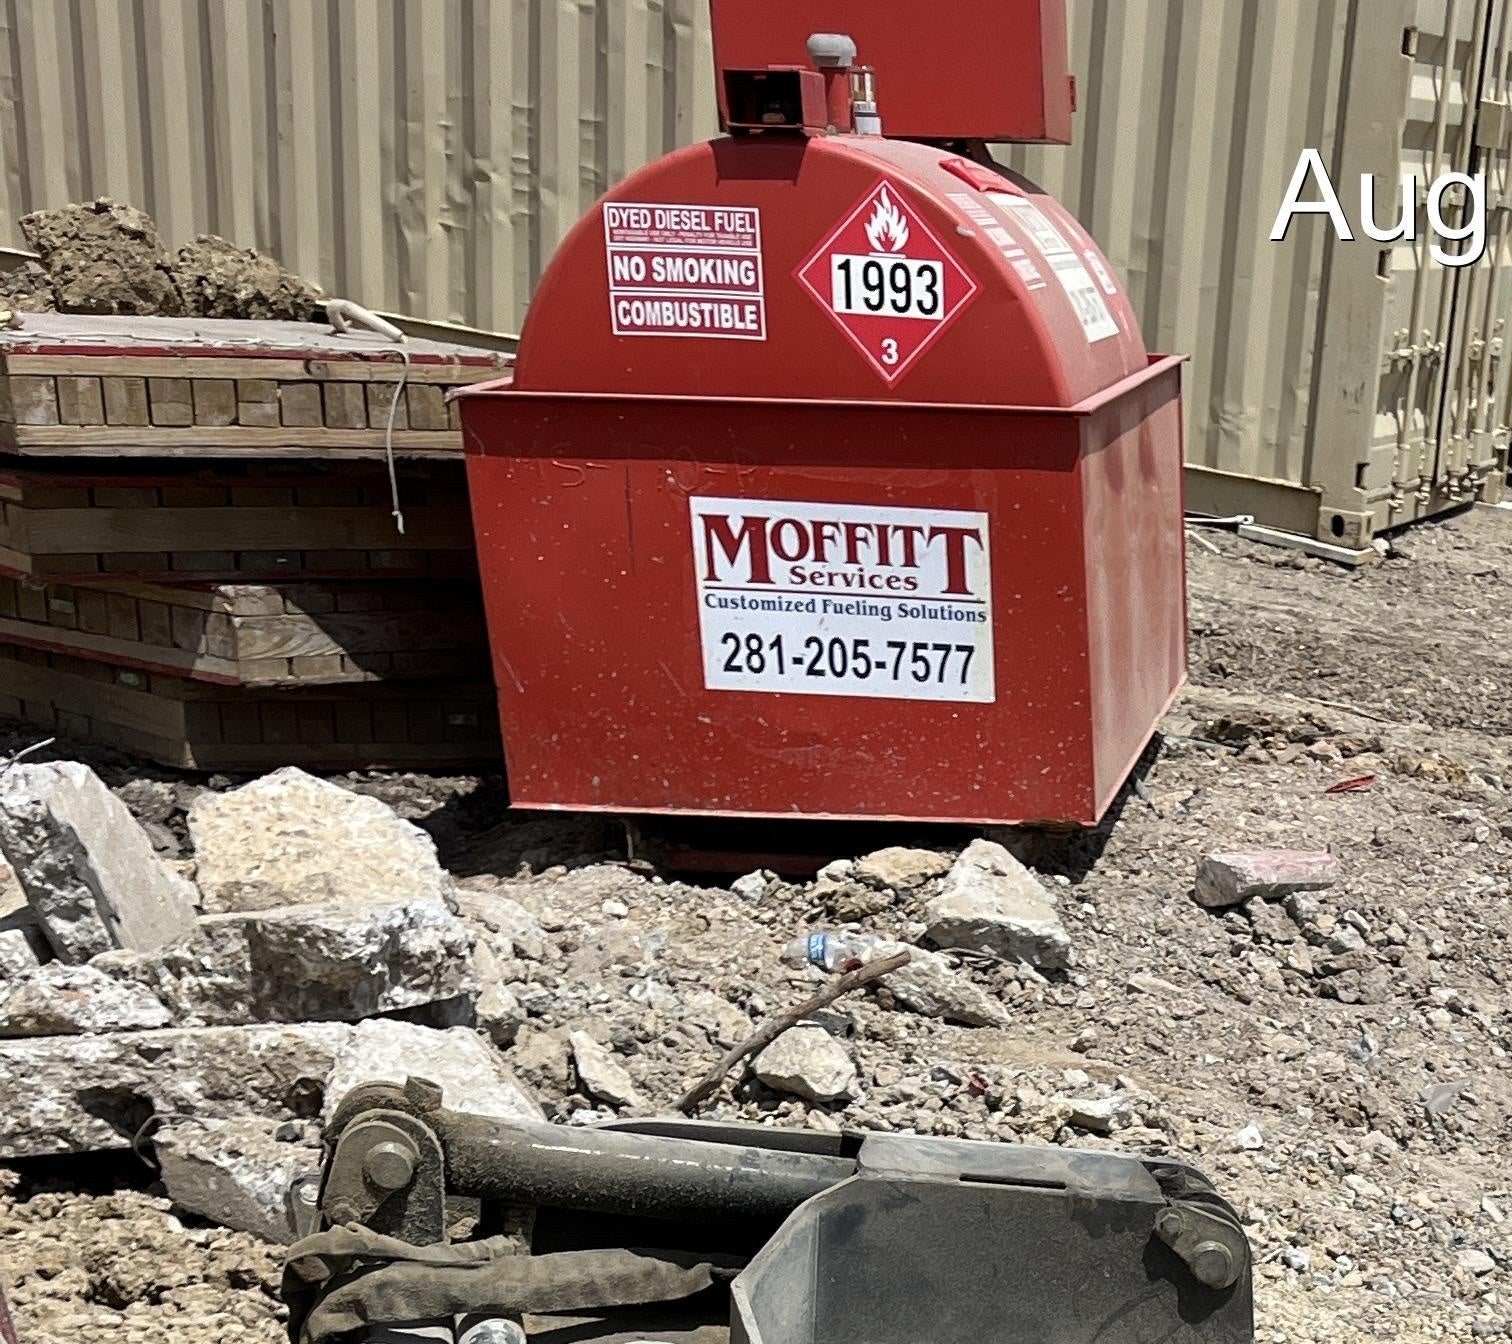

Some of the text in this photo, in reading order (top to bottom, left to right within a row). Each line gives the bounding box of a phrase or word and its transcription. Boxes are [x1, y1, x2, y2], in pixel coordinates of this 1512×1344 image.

[608, 207, 756, 233] DYED DIESEL FUEL
[613, 255, 756, 286] NO SMOKING
[836, 258, 939, 316] 1993
[617, 300, 759, 330] COMBUSTIBLE
[880, 337, 899, 366] 3
[698, 513, 985, 596] MOFFITT
[789, 566, 918, 591] Services
[704, 593, 988, 624] Customized Fueling Solutions
[720, 631, 976, 685] 281-205-7577
